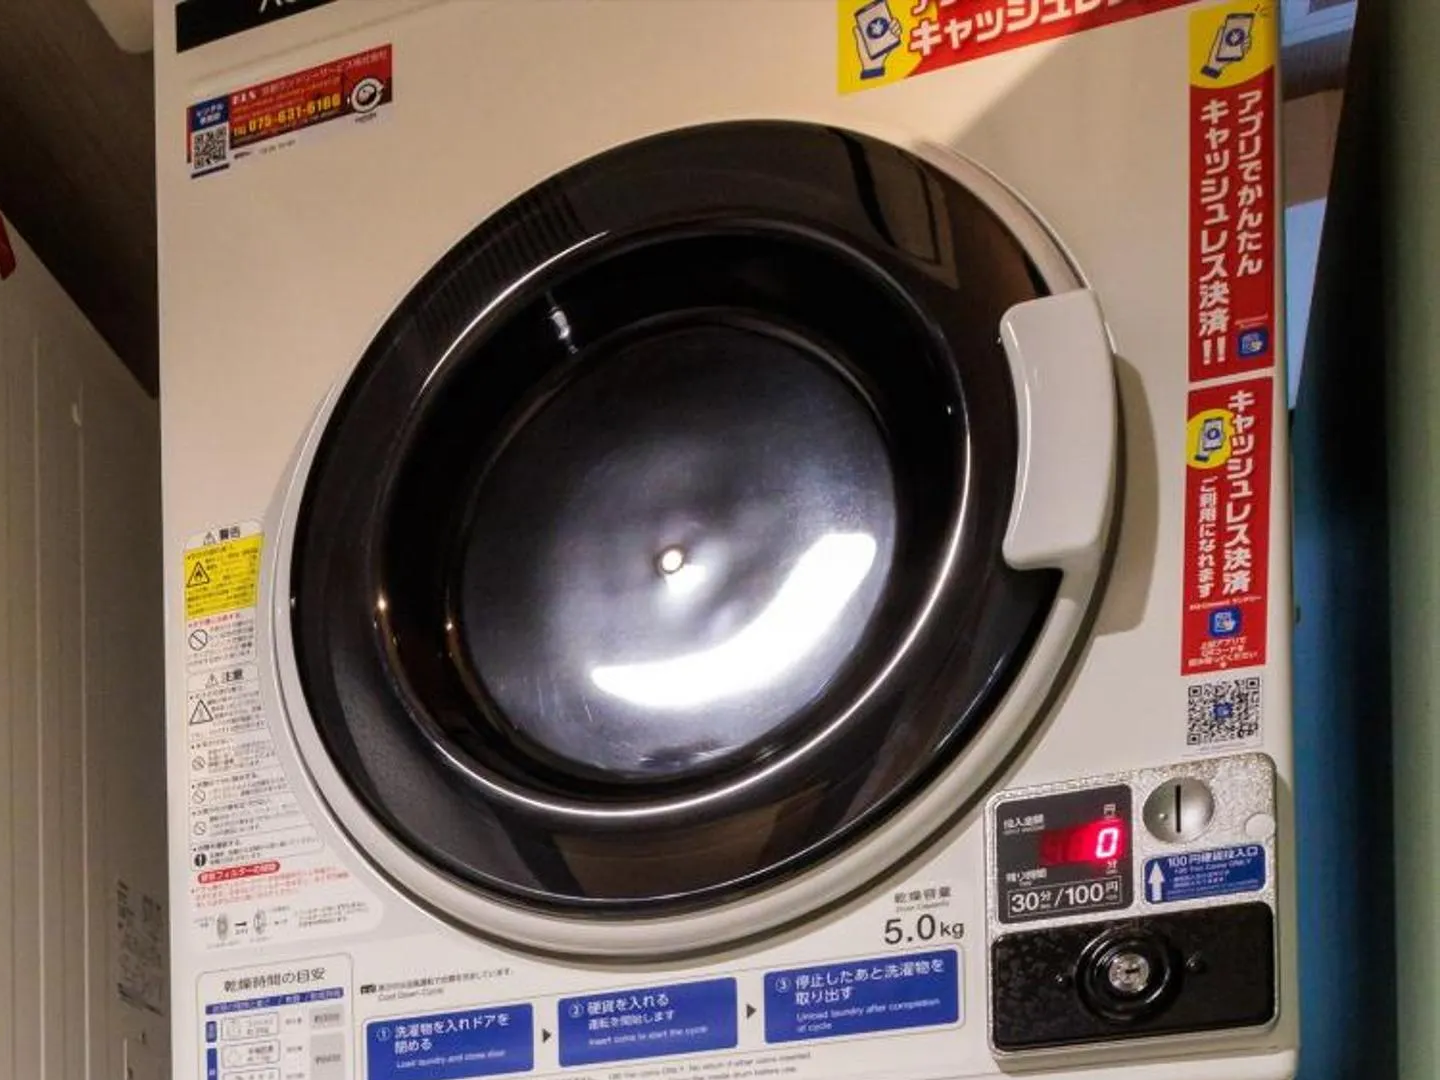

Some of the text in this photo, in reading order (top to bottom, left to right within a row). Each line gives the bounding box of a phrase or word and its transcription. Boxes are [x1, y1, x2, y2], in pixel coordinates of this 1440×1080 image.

[911, 0, 1121, 56] キャッシュ
[1237, 90, 1263, 278] アプリでかんたん
[1199, 99, 1230, 366] キャッシュレス決済!!
[1222, 389, 1256, 597] キャッシュレス決済
[1095, 827, 1119, 859] 0
[796, 959, 944, 989] 停止したあと洗濯物を
[587, 994, 670, 1015] 硬貨を入れる
[795, 986, 855, 1006] 取り出す
[395, 1013, 510, 1038] 洗濯物を入れドアを
